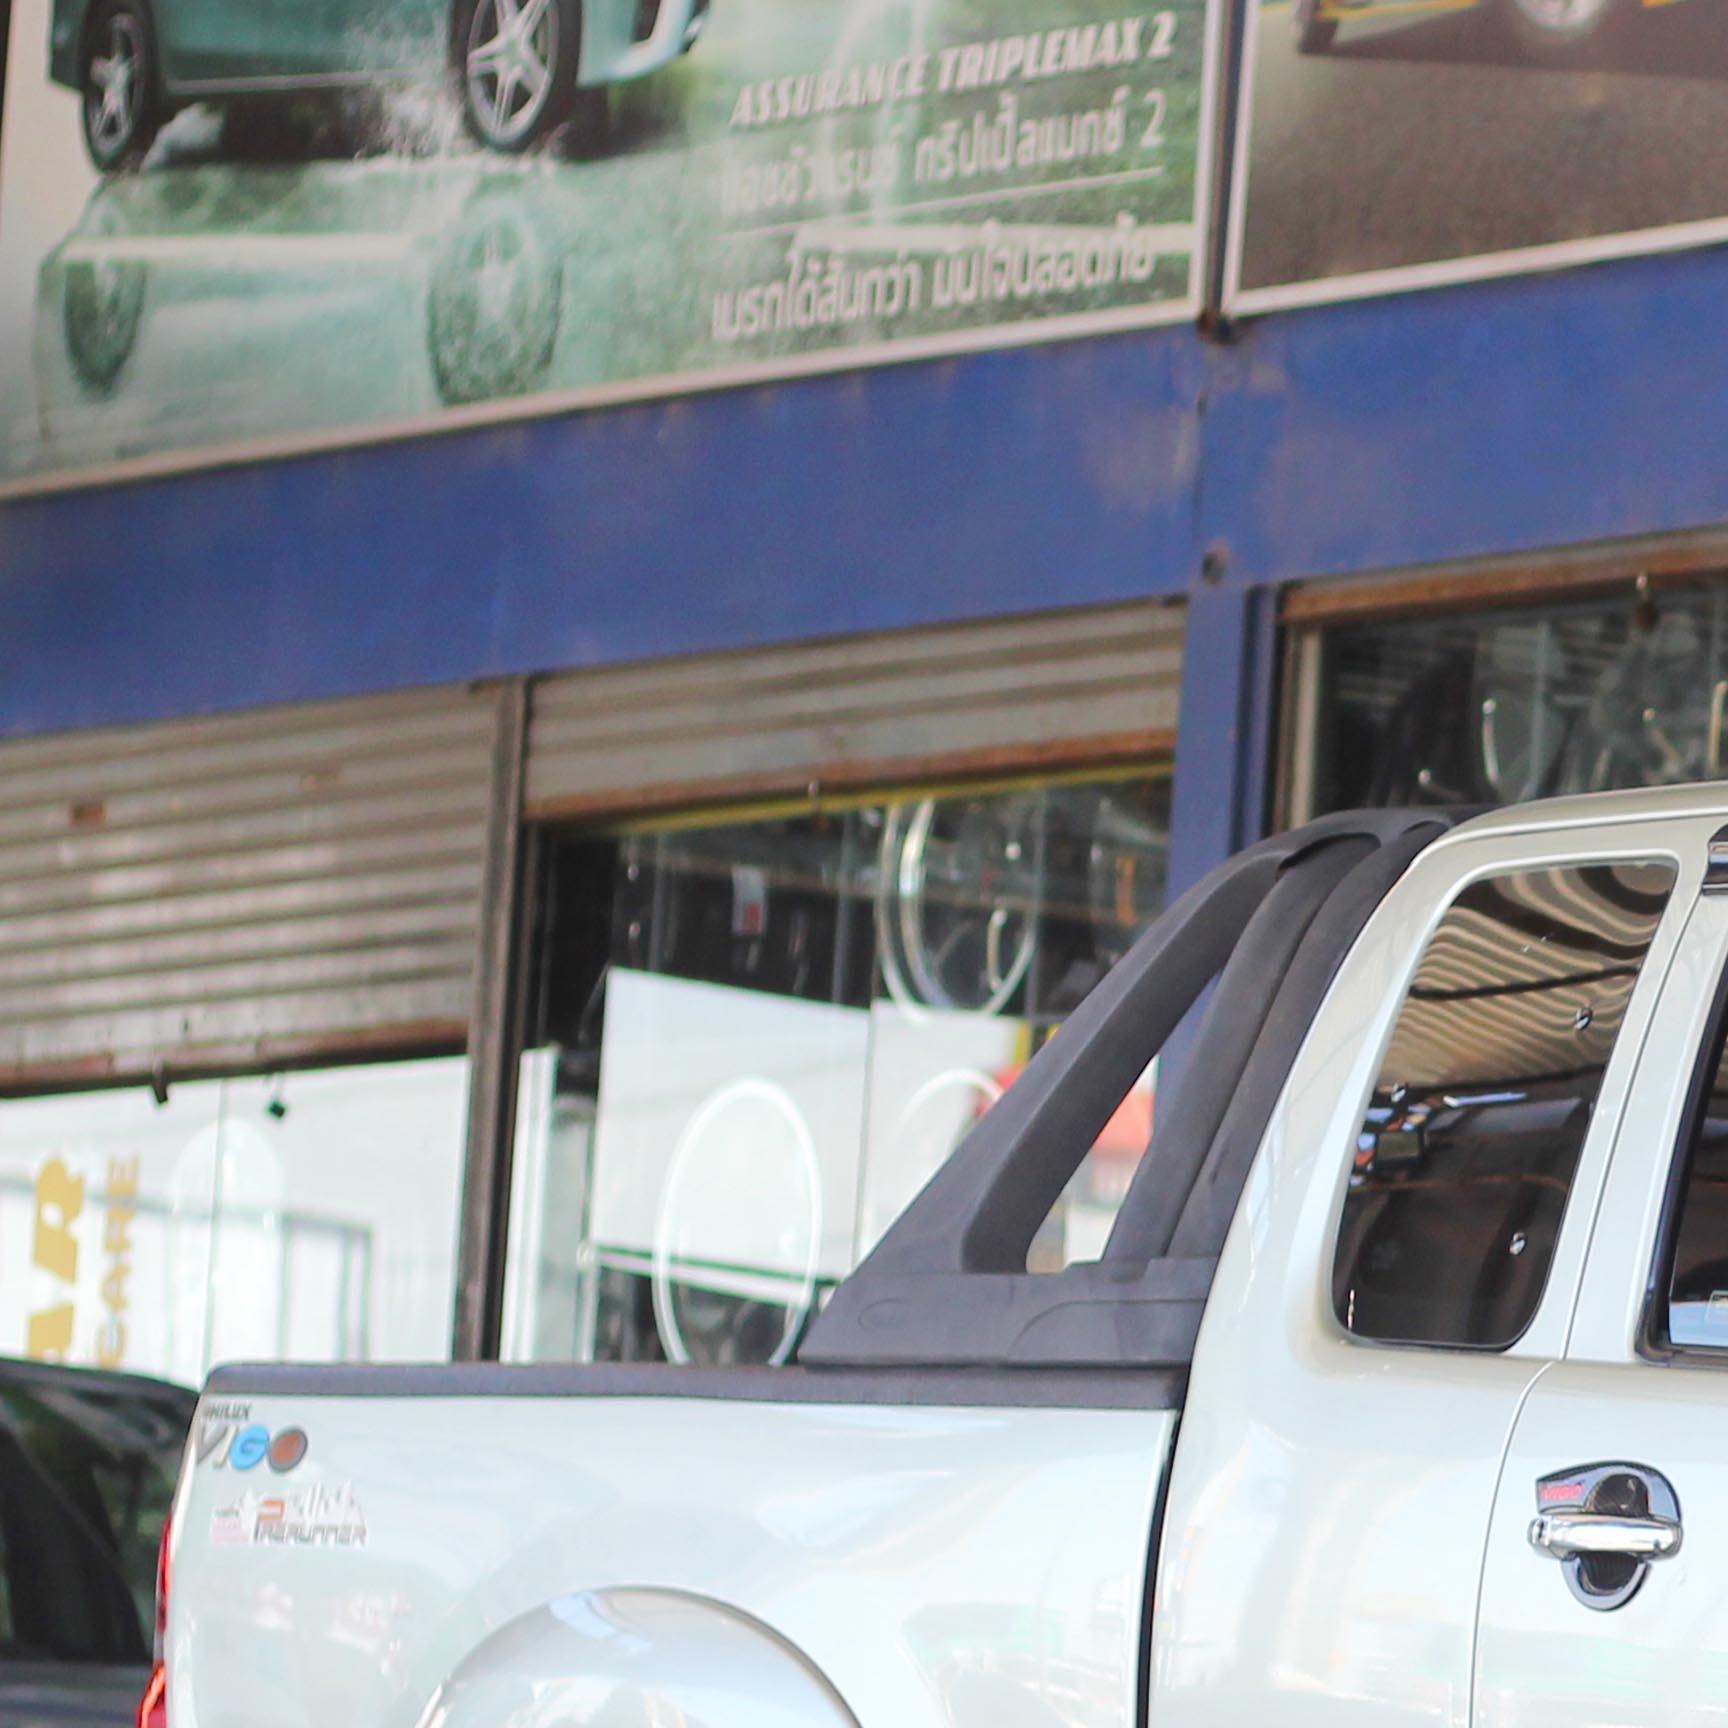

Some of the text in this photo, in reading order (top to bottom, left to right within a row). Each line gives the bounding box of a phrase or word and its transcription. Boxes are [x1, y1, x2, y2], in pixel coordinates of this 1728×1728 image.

[729, 11, 1178, 130] ASSURANCE TRIPLEMAX 2
[1140, 89, 1166, 148] 2
